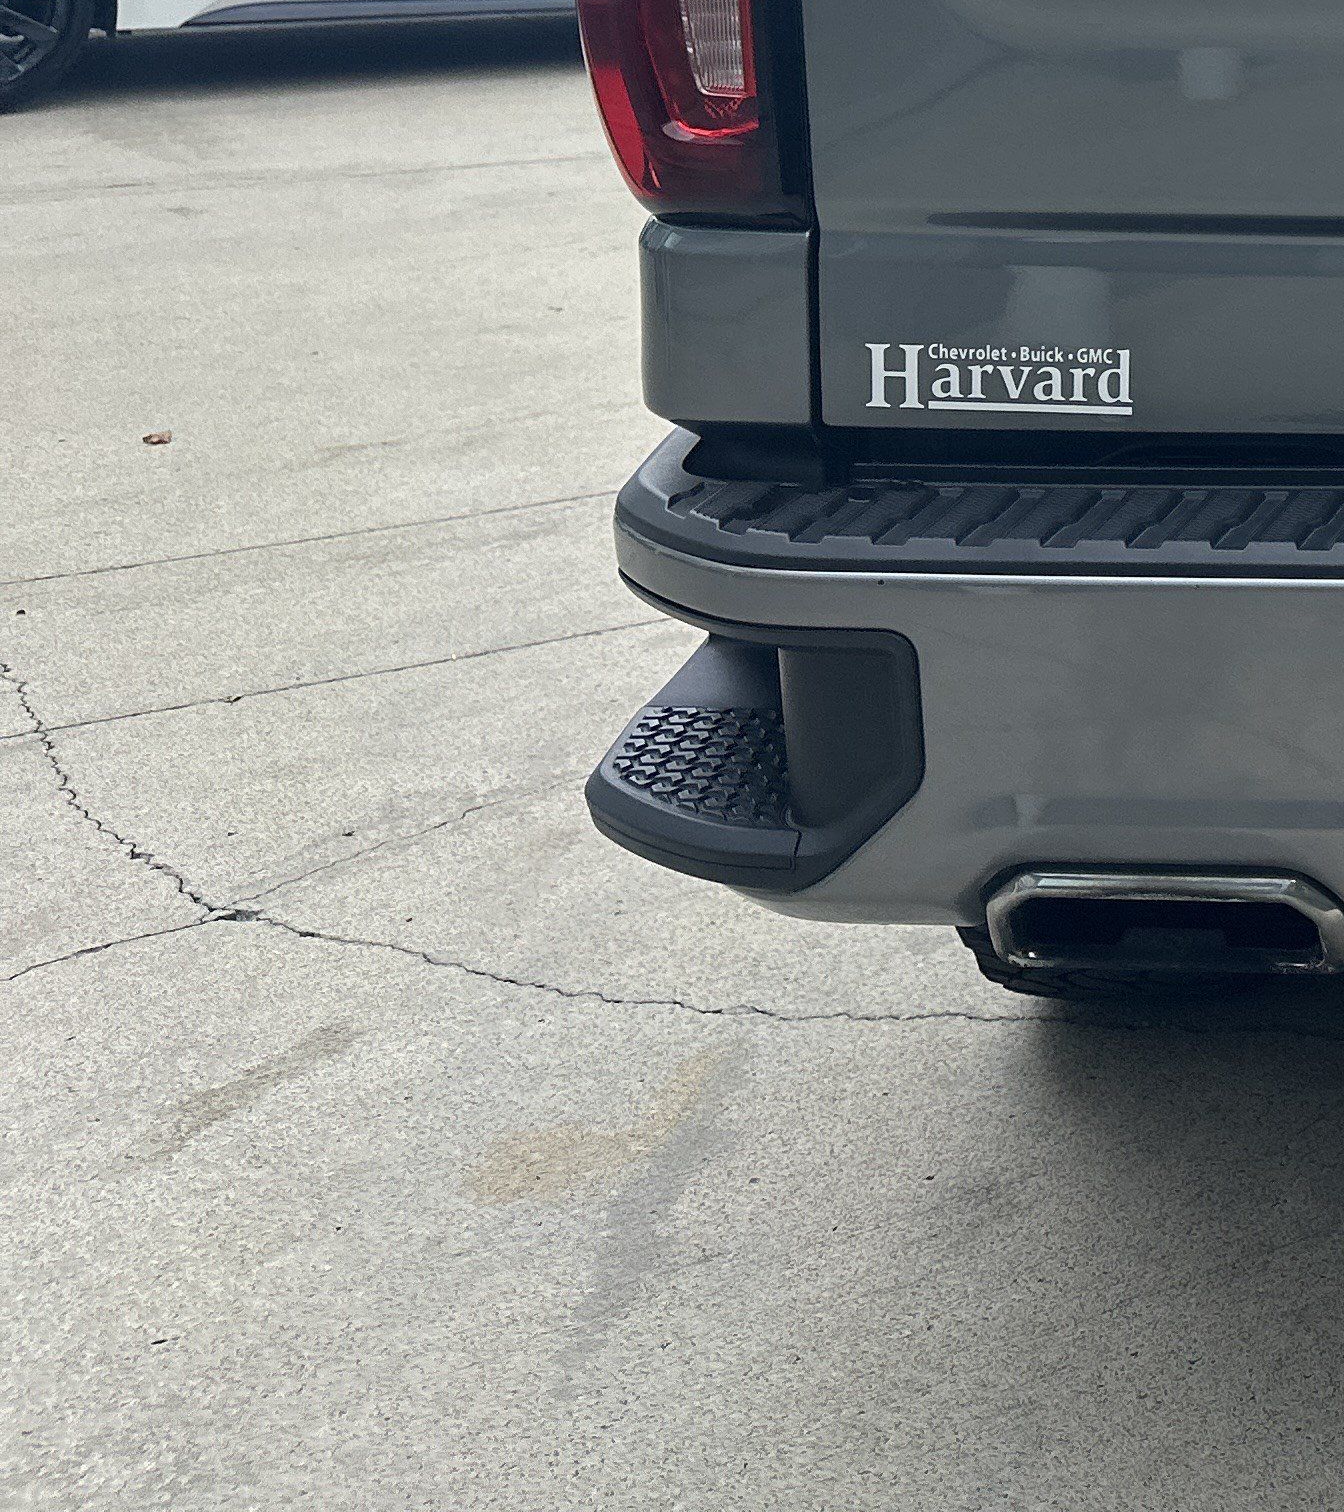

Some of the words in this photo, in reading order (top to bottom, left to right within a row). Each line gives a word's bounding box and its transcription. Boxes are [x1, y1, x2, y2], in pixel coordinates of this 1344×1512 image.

[928, 343, 1008, 361] Chevrolet
[1019, 345, 1064, 363] Buick
[1076, 348, 1113, 364] GMC
[864, 342, 1134, 410] Harvard
